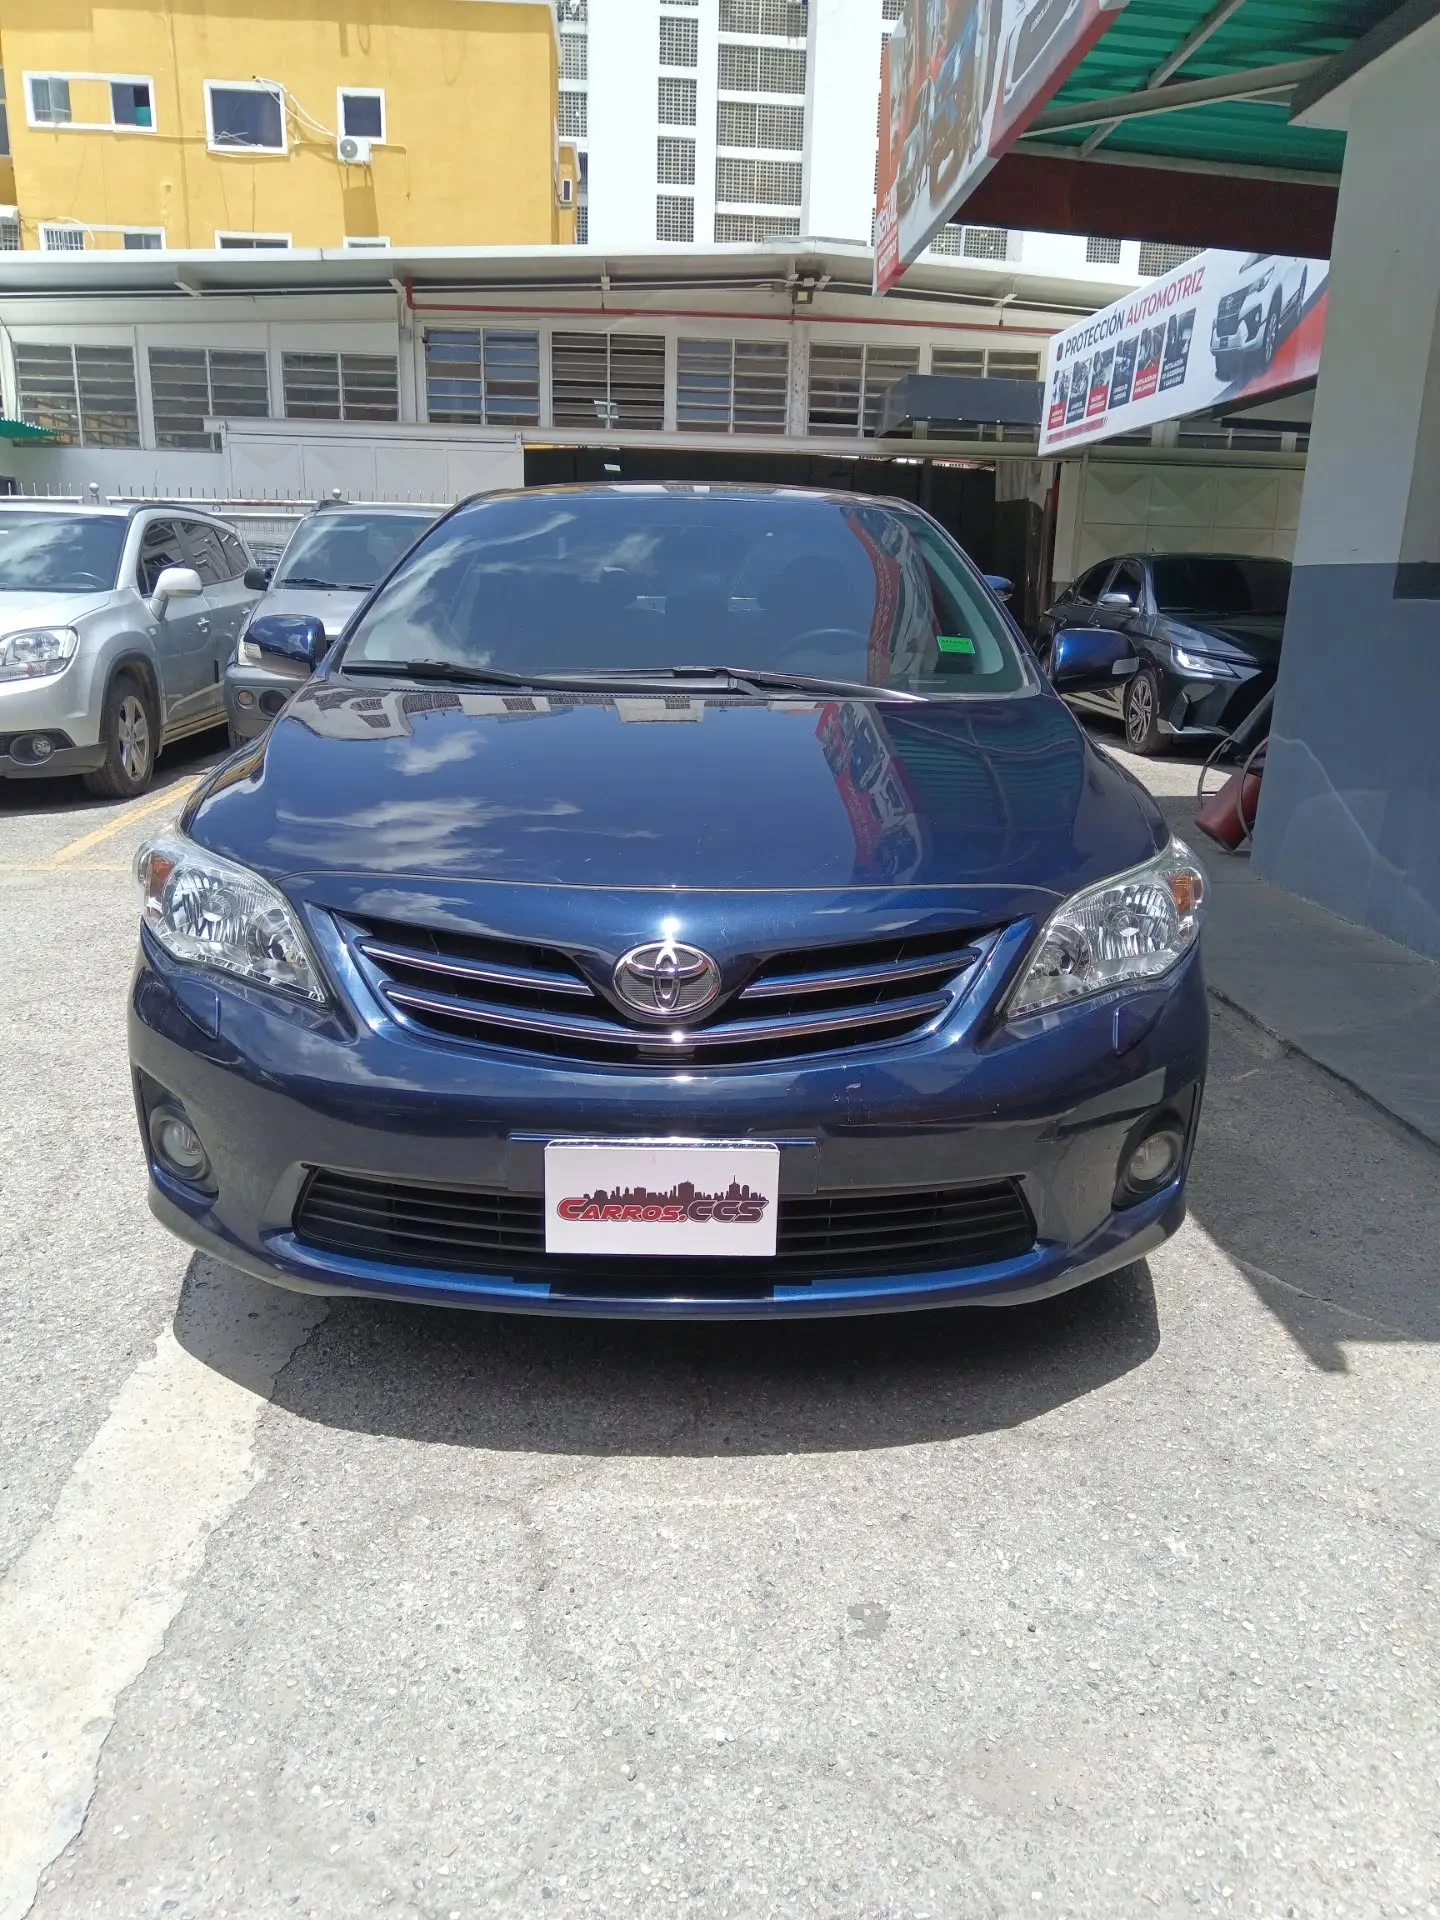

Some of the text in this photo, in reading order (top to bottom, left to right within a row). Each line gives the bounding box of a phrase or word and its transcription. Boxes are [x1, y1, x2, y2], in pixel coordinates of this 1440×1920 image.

[1065, 266, 1206, 358] PROTECCIÓN AUTOMOTRIZ
[557, 1197, 769, 1223] CARROS.CCS
